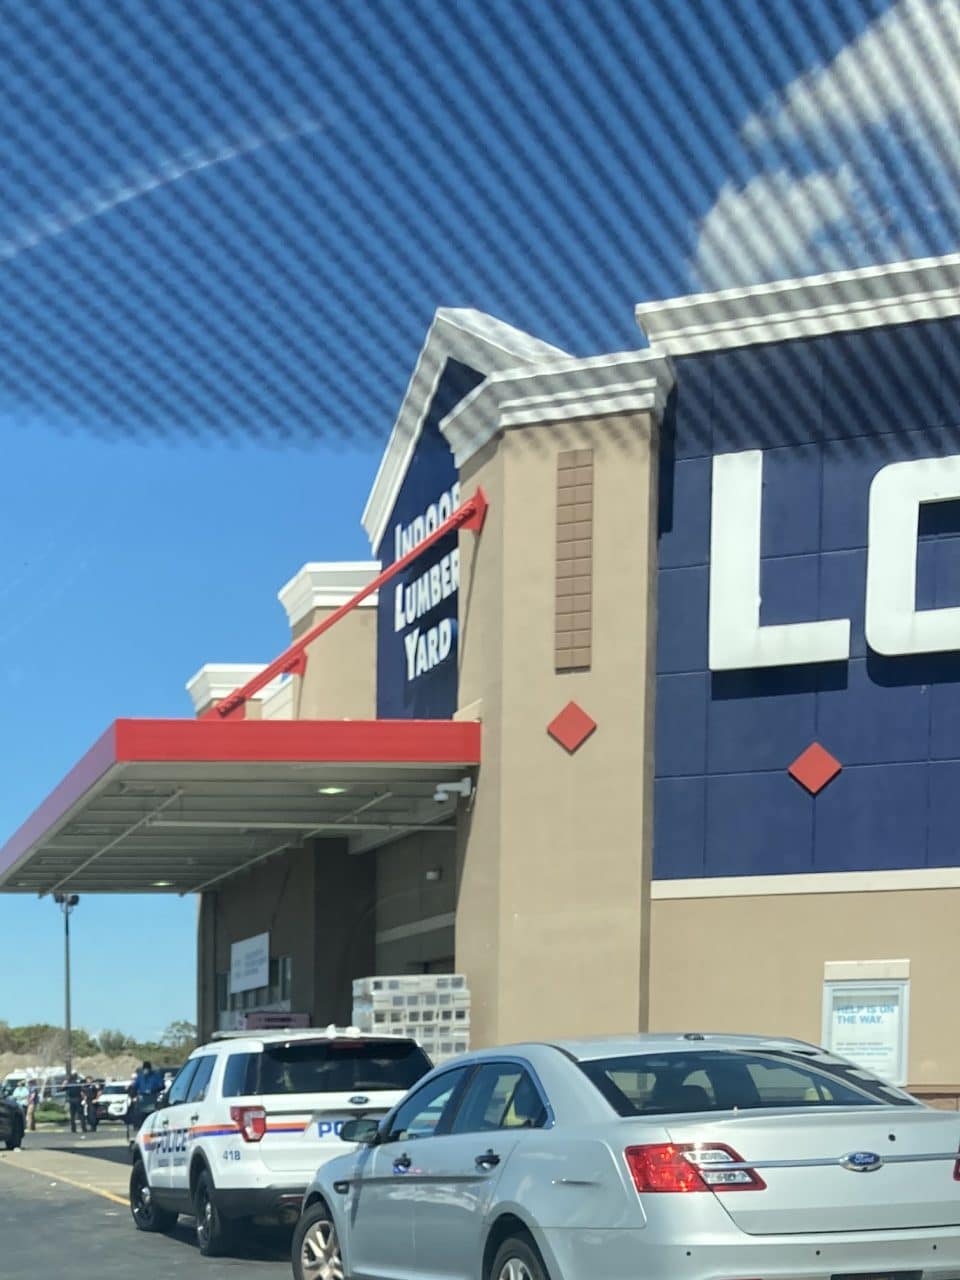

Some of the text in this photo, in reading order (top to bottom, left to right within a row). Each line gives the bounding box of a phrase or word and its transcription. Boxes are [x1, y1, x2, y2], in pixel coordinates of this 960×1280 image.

[394, 548, 460, 632] LUMBER
[403, 617, 452, 681] YARD
[837, 1015, 857, 1025] THE
[155, 1128, 188, 1154] POLICE
